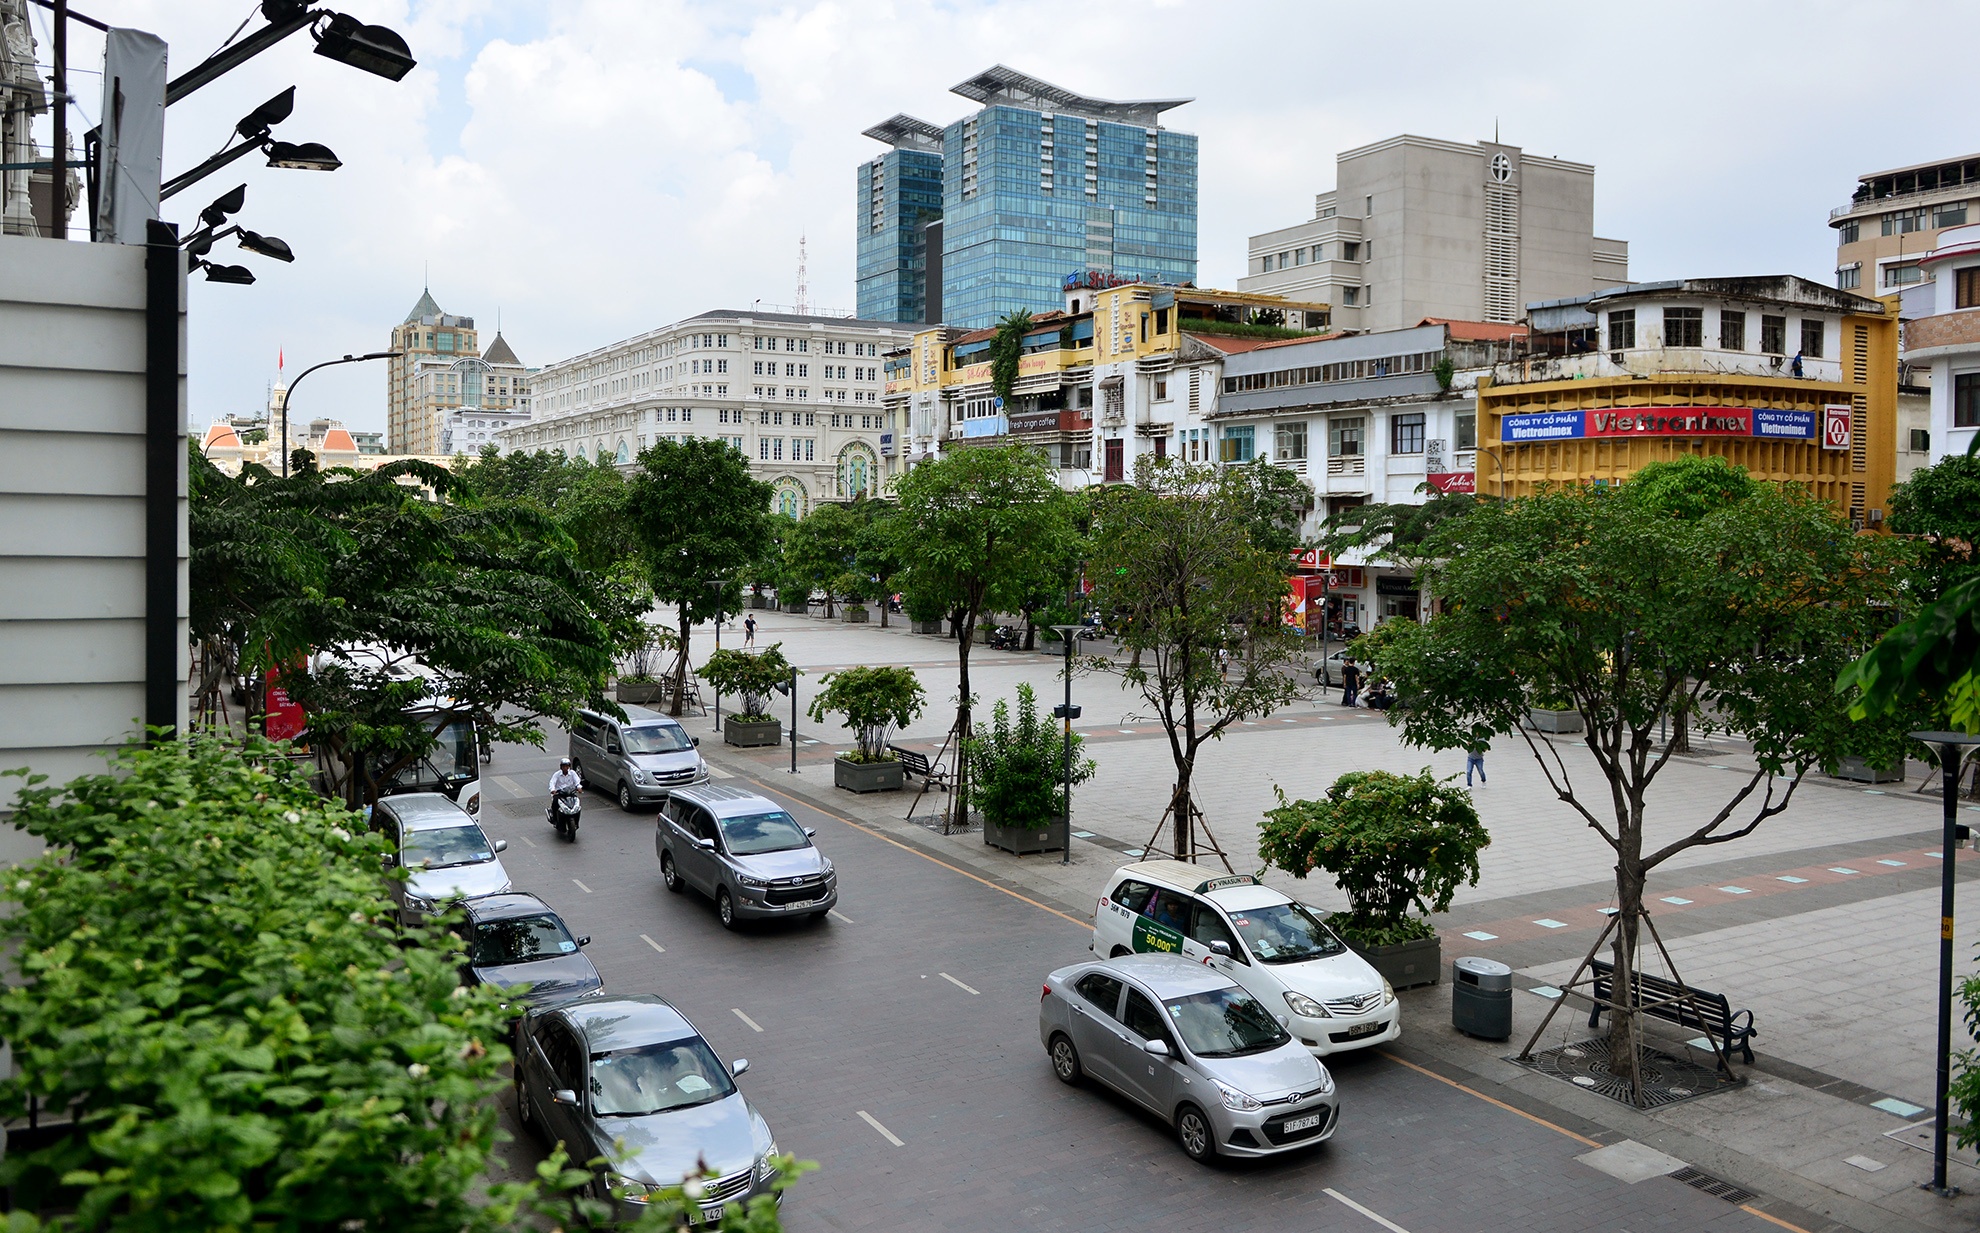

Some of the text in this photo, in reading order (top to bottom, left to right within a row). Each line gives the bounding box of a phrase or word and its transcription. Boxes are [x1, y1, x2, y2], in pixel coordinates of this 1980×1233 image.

[1009, 420, 1023, 429] fresh
[1038, 416, 1056, 426] coffee
[1531, 417, 1542, 425] TY
[1593, 411, 1747, 433] Viettronimex
[1776, 414, 1784, 422] TY
[1512, 426, 1572, 439] Viettronimex
[1761, 422, 1806, 436] Viettronimex
[1145, 933, 1171, 952] 50.000
